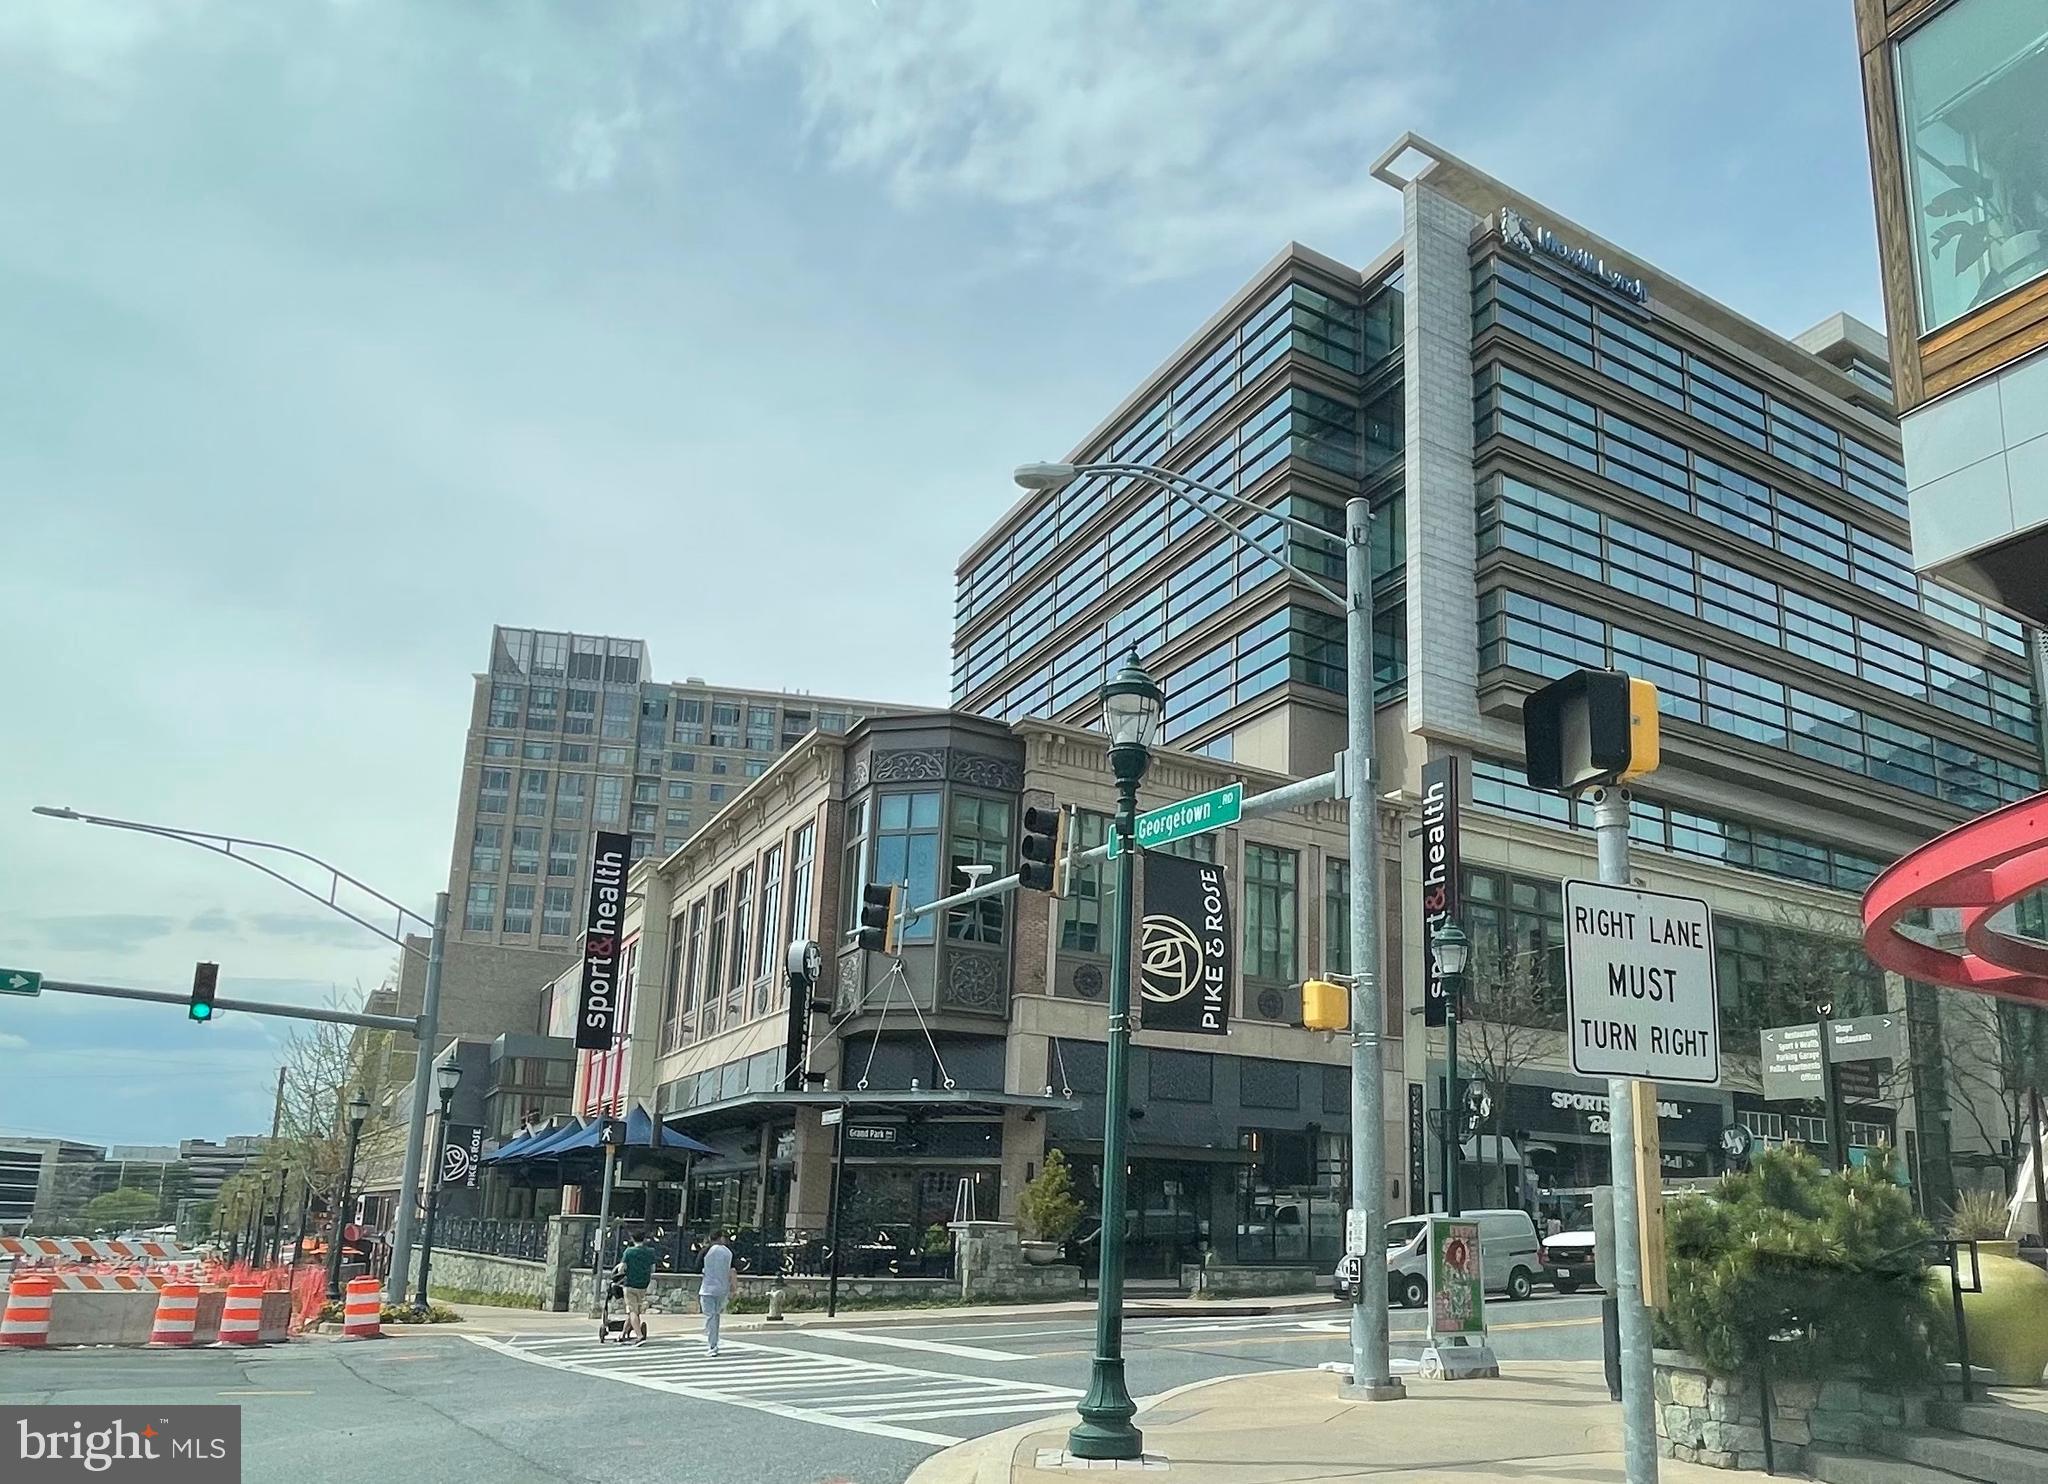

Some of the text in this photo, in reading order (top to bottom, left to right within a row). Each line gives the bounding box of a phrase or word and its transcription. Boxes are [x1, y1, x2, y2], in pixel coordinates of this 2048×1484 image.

[1138, 791, 1234, 839] Georgetown RD
[1575, 906, 1704, 949] RIGHT LANE
[1200, 869, 1225, 1029] PIKE & ROSE
[1608, 962, 1677, 1003] MUST
[1580, 1019, 1709, 1058] TURN RIGHT
[470, 1128, 482, 1154] ROSE
[849, 1128, 868, 1138] Grand
[869, 1129, 885, 1139] Park
[467, 1164, 478, 1187] PIKE
